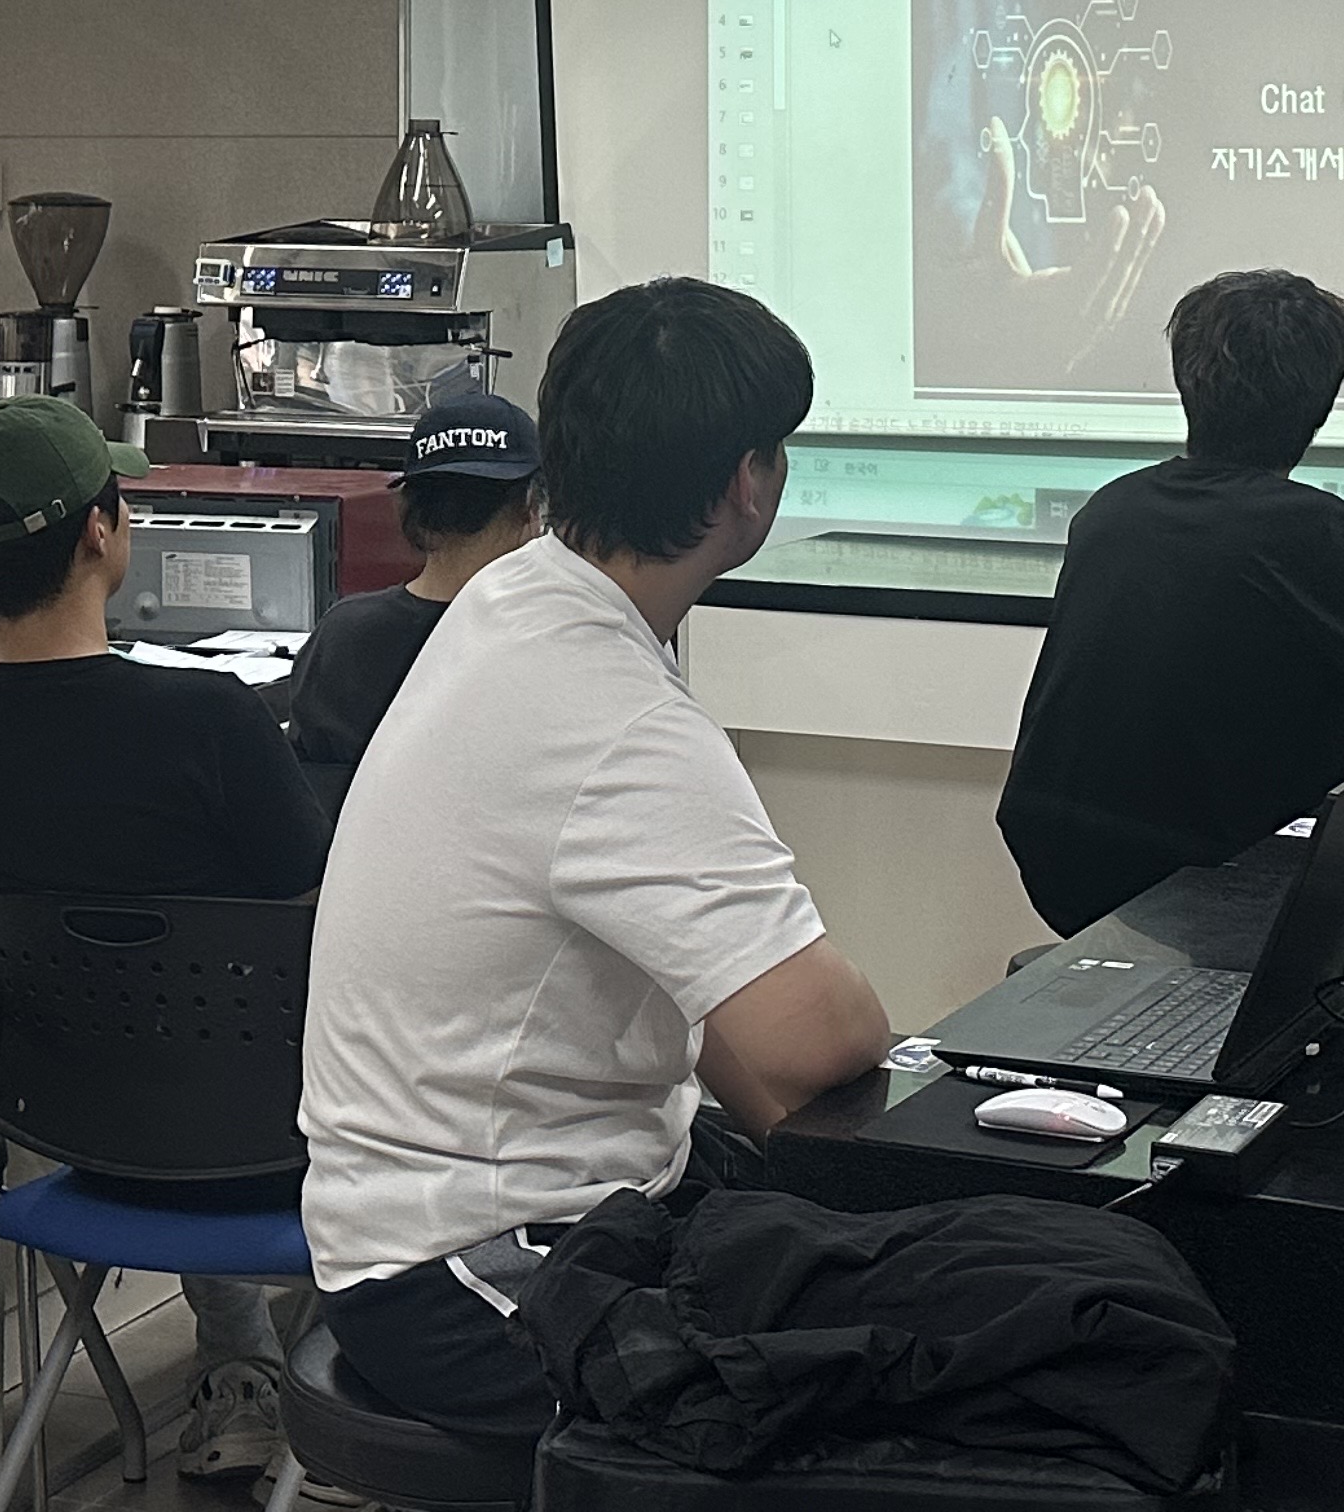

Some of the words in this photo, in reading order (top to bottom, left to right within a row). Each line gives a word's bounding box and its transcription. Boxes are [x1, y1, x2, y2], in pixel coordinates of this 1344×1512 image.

[1261, 82, 1326, 114] Chat
[1211, 146, 1344, 181] 자기소개서
[416, 428, 508, 460] FANTOM
[844, 462, 878, 476] 한국어
